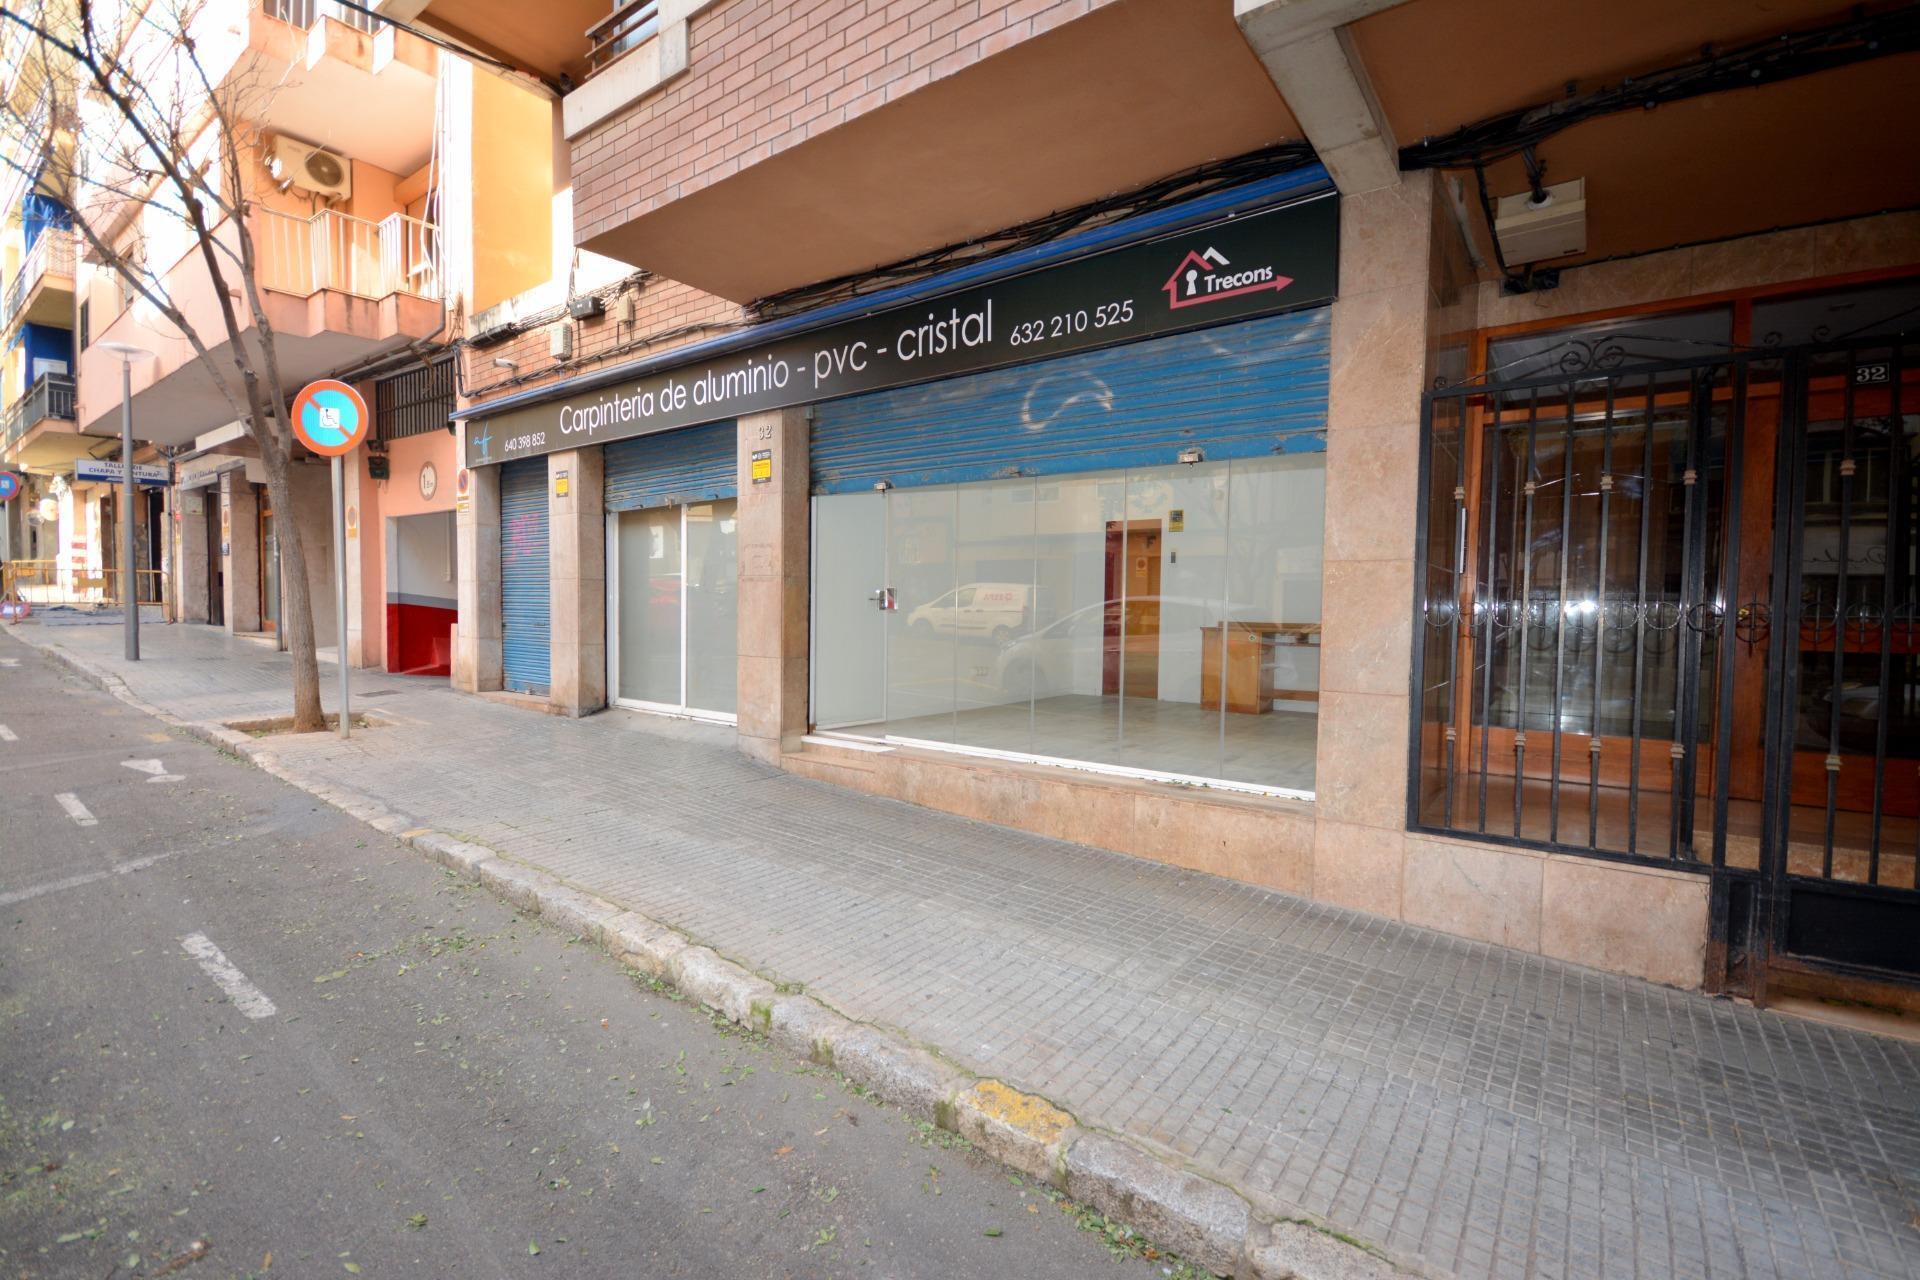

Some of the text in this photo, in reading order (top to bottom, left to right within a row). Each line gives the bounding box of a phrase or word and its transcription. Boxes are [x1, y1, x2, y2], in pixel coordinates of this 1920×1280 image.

[1204, 266, 1273, 292] Trecons
[1010, 300, 1134, 346] 632 210 525
[559, 387, 654, 435] Carpinteria
[660, 379, 687, 412] de
[693, 354, 789, 405] aluminio
[814, 341, 867, 389] pvc
[897, 299, 992, 361] cristal
[1857, 366, 1886, 382] 32
[504, 432, 546, 452] 640 398 852
[759, 424, 772, 440] 32
